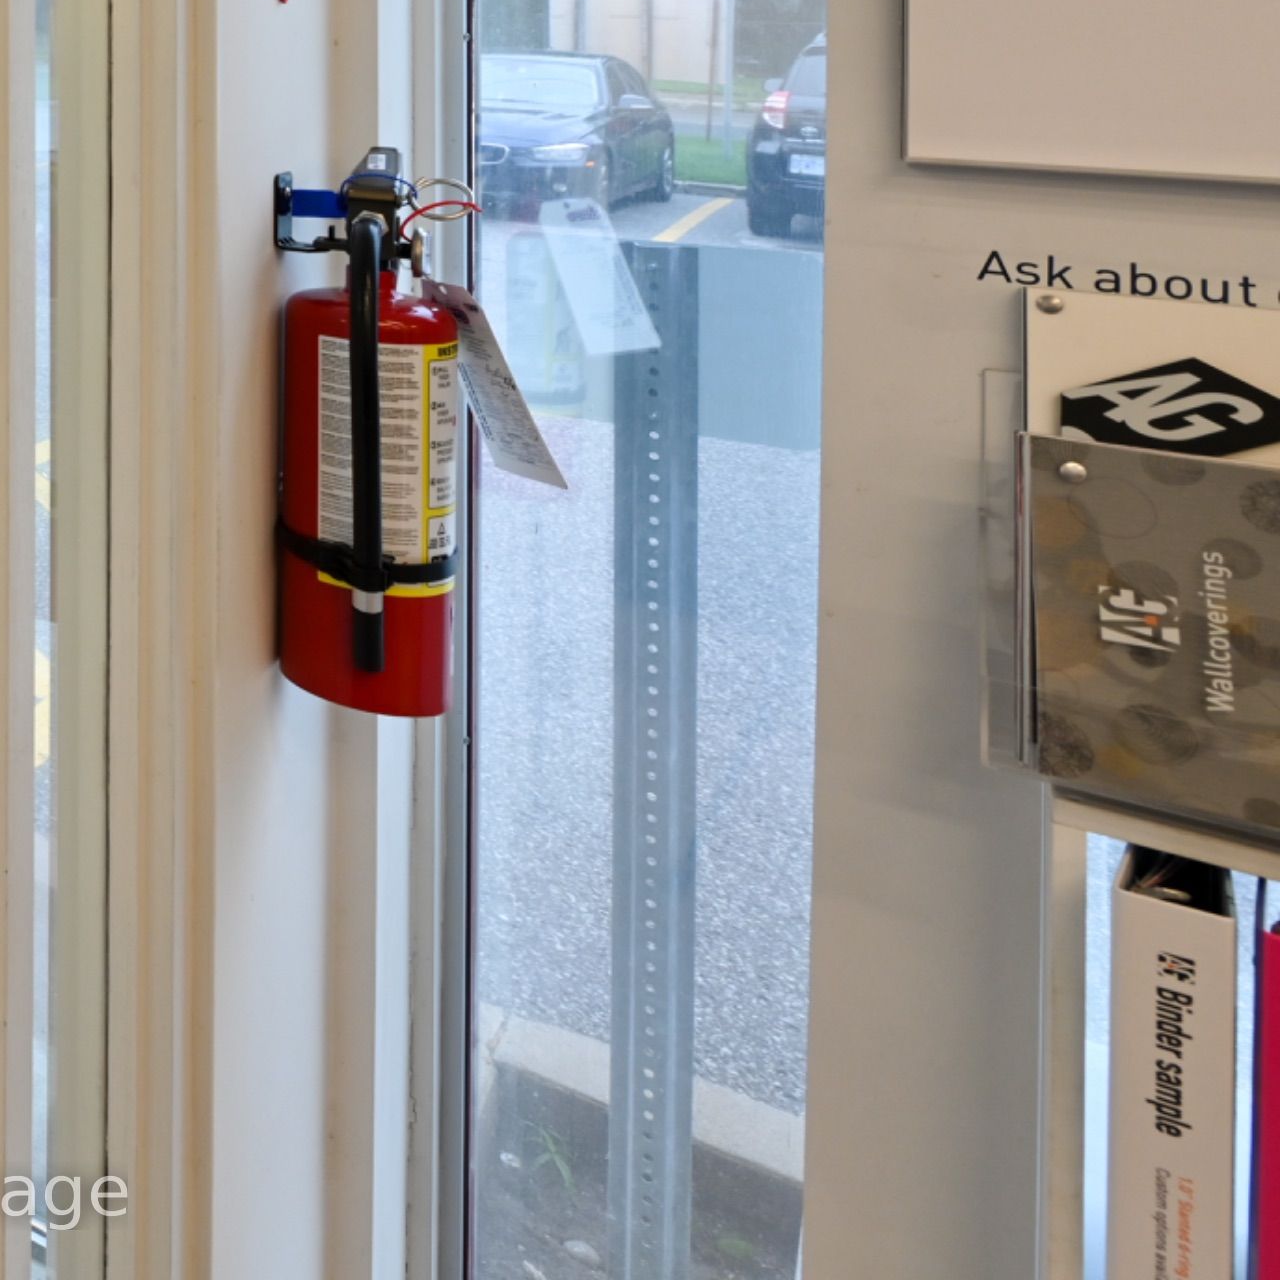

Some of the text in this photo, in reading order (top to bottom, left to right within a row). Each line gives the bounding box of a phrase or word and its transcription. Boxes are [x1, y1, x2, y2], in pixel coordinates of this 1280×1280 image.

[976, 250, 1258, 308] Ask about
[1197, 551, 1236, 712] Wallcoverings
[1155, 986, 1194, 1060] Binder
[1144, 1058, 1193, 1138] sample
